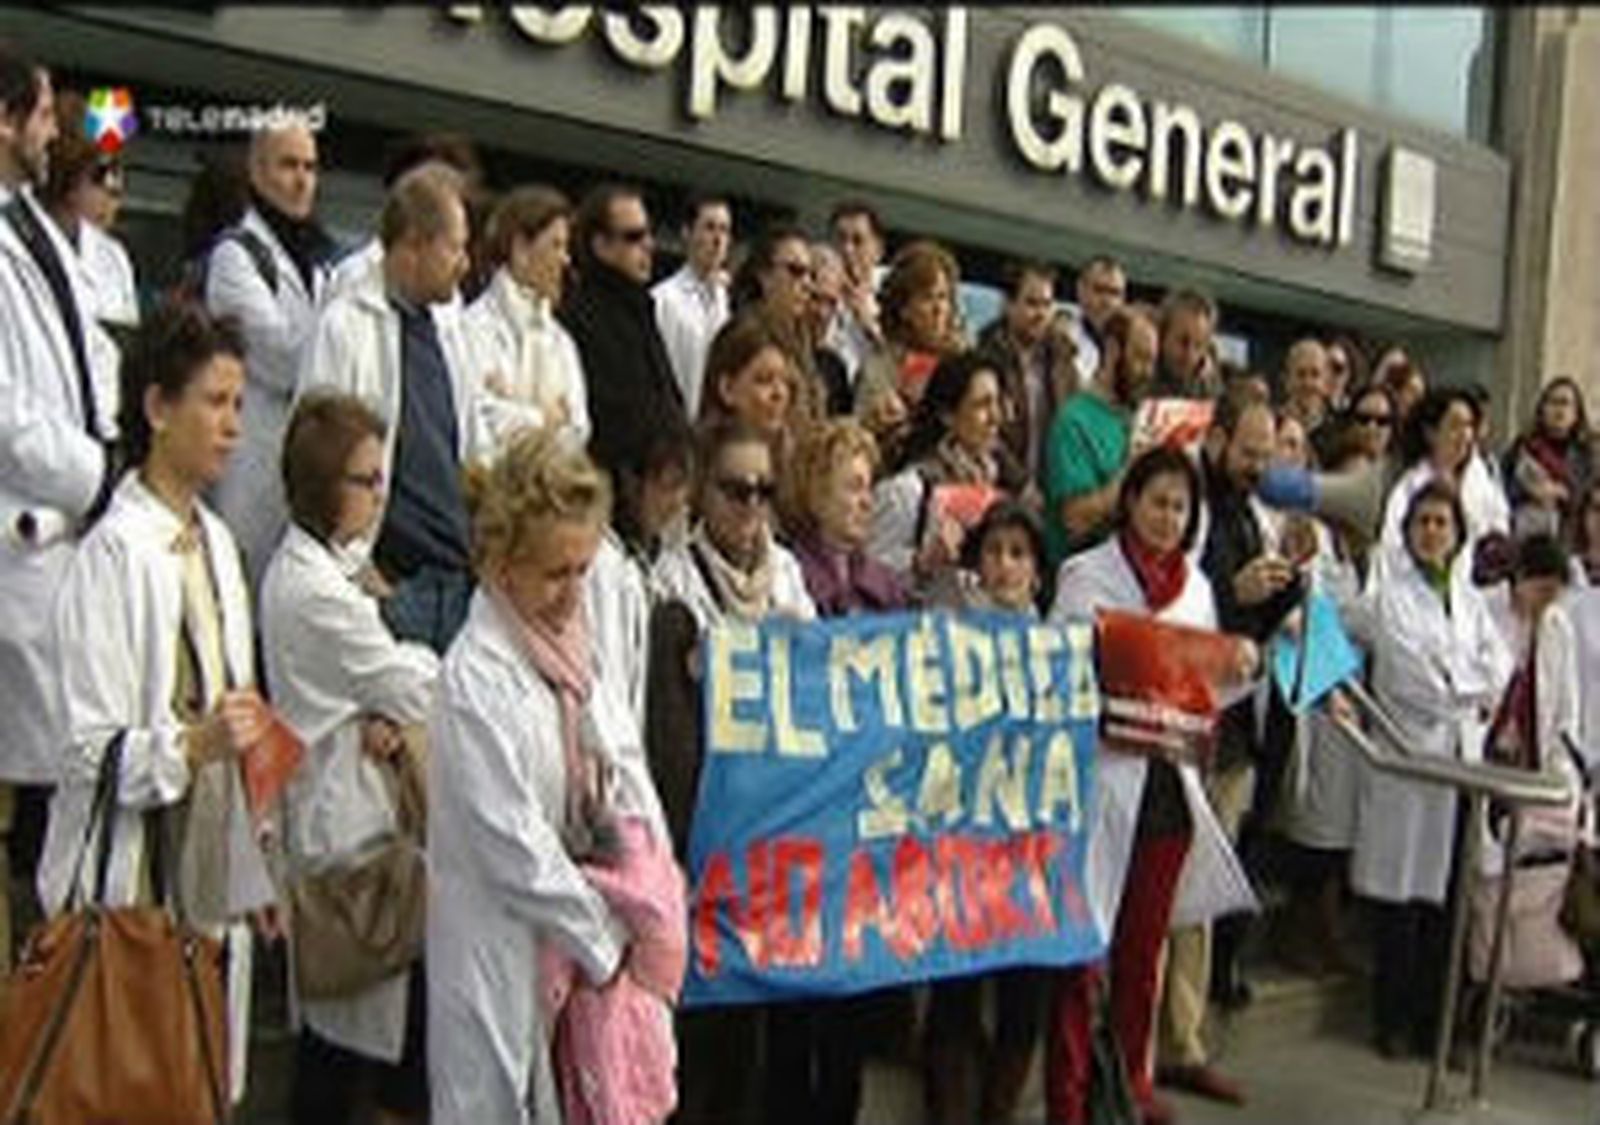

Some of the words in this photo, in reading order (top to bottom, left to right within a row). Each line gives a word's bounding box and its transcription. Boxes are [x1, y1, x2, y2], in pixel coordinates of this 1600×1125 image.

[446, 6, 968, 140] spital
[1007, 23, 1358, 245] General
[709, 624, 829, 758] EL
[857, 729, 1080, 839] SANA
[696, 836, 824, 978] NO
